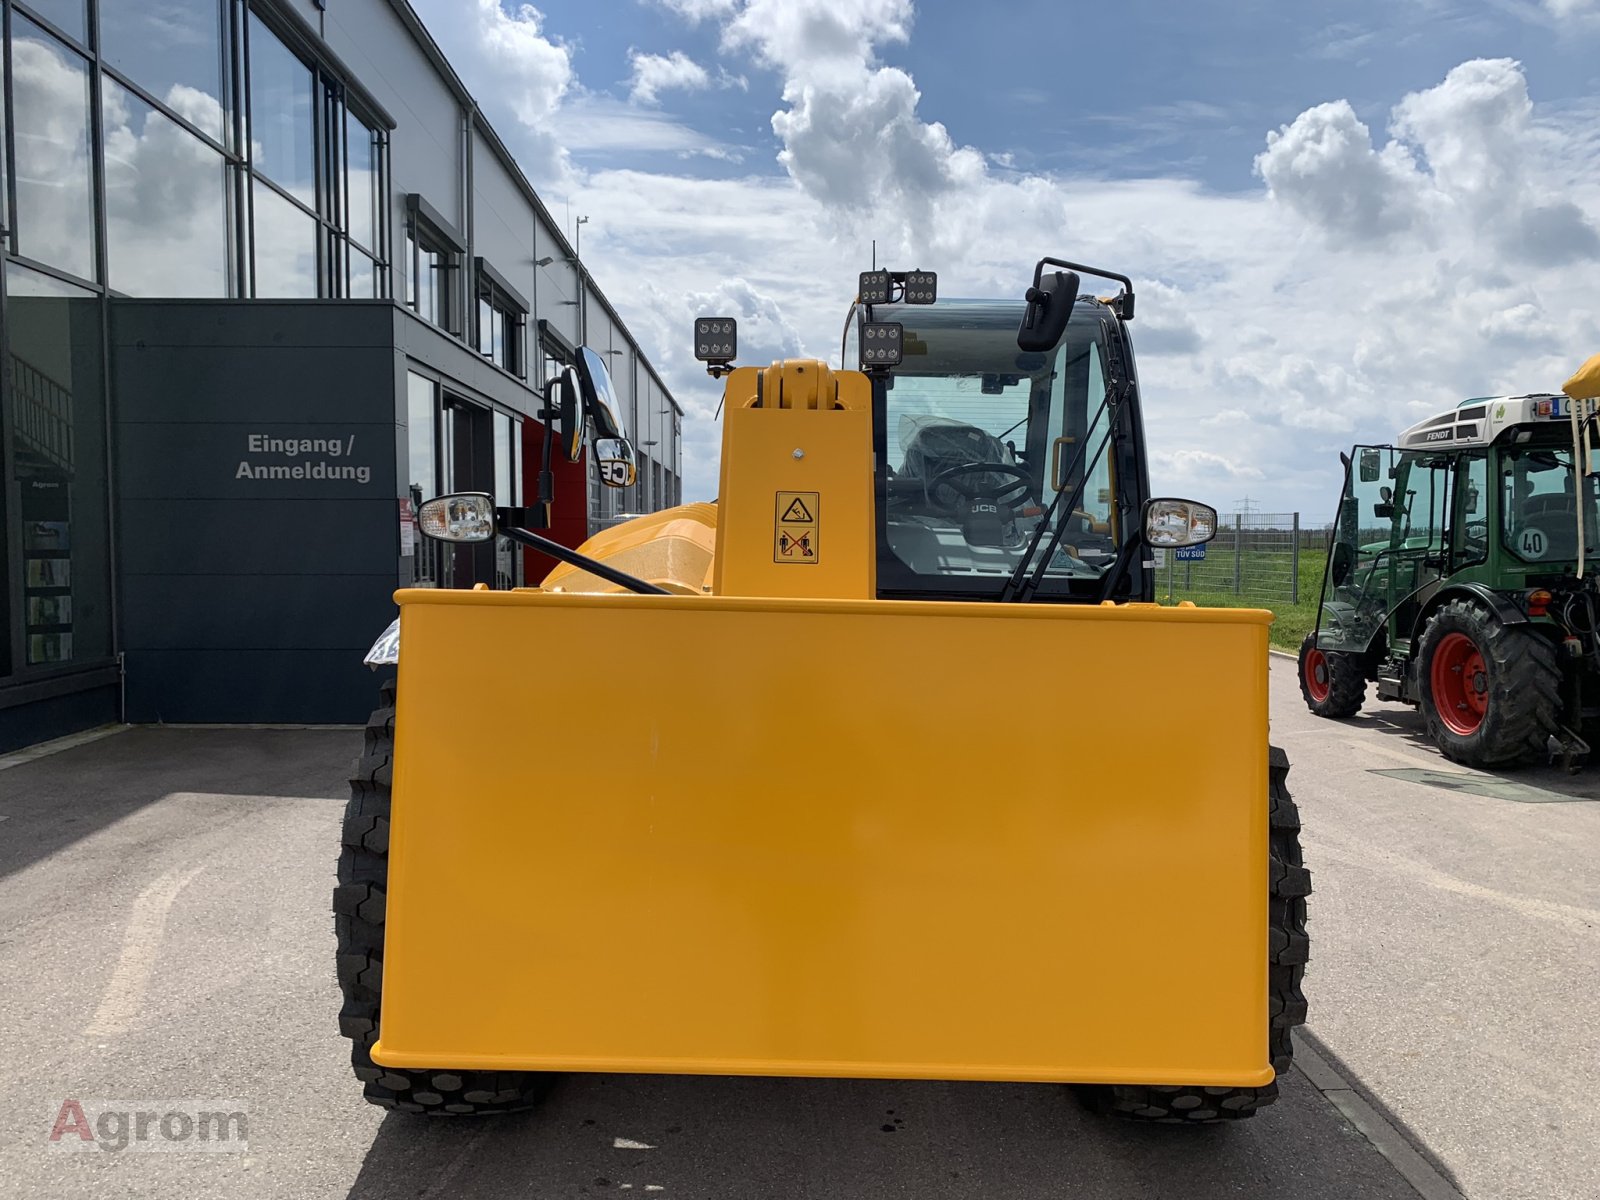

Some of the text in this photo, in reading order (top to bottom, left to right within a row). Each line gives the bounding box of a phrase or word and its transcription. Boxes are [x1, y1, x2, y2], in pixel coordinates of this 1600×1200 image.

[1426, 430, 1450, 441] FENDT
[248, 434, 355, 457] Eingang /
[235, 461, 371, 484] Anmeldung
[971, 504, 997, 513] JCB
[1523, 533, 1542, 553] 40
[1176, 549, 1191, 558] TÜV
[1191, 549, 1205, 558] SÜD
